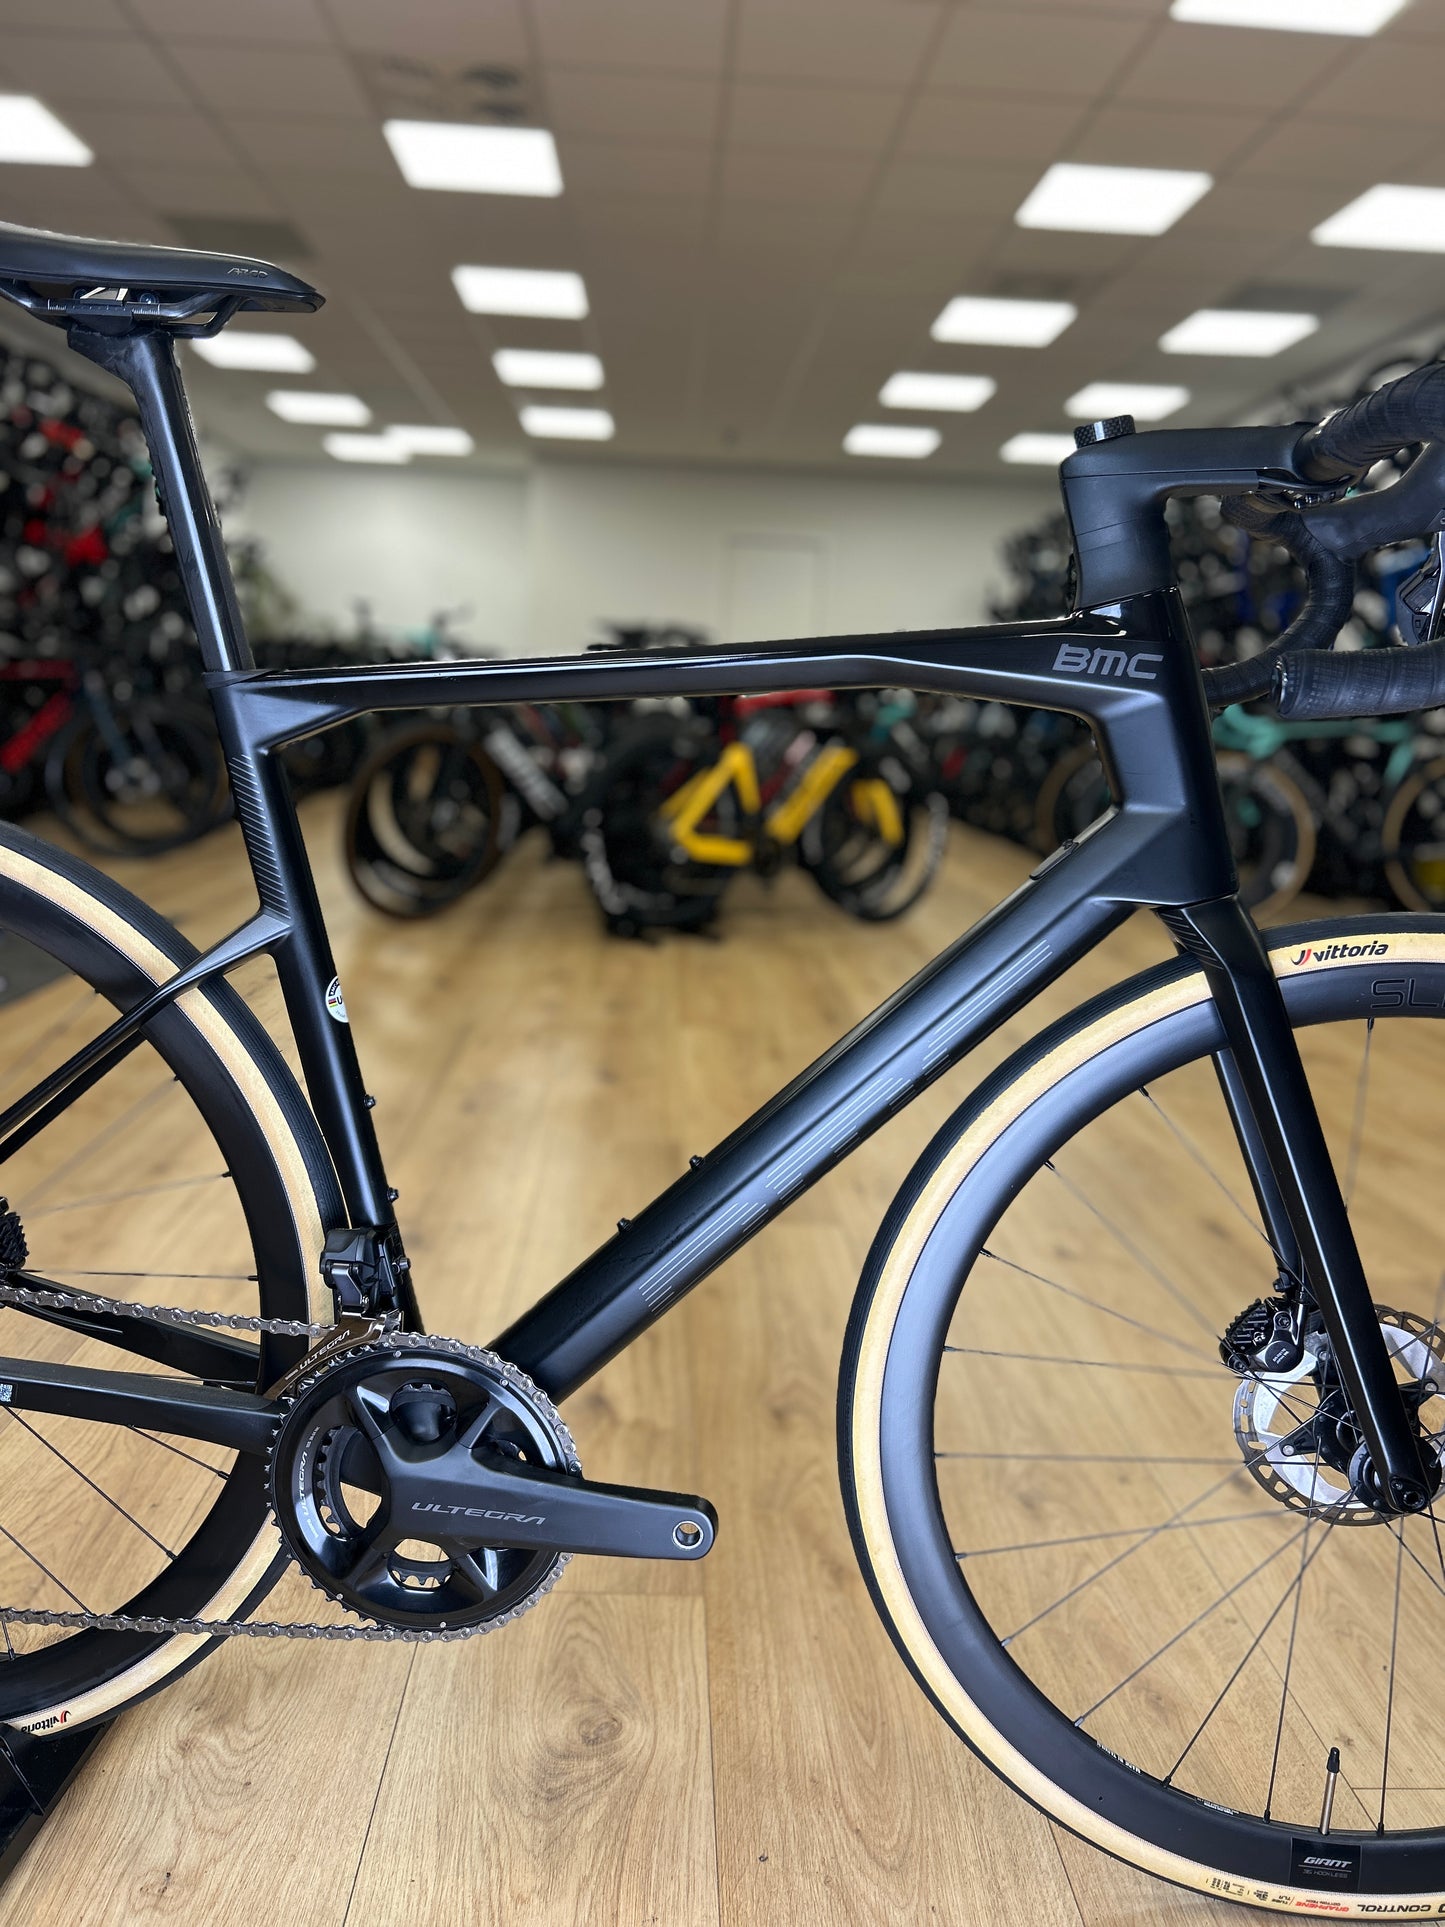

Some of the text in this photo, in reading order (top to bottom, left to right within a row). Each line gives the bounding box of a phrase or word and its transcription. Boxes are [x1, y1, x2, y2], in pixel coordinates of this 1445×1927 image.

[1052, 643, 1164, 680] BMC
[1313, 941, 1389, 962] vittoria
[1370, 978, 1445, 1009] SL
[299, 1329, 350, 1370] ULTEGRA
[298, 1451, 309, 1516] ULTEGRA
[411, 1502, 547, 1525] ULTEGRA
[1303, 1856, 1353, 1868] GIANT
[1295, 1901, 1350, 1913] GRAPHENE
[1357, 1904, 1431, 1913] CONTROL
